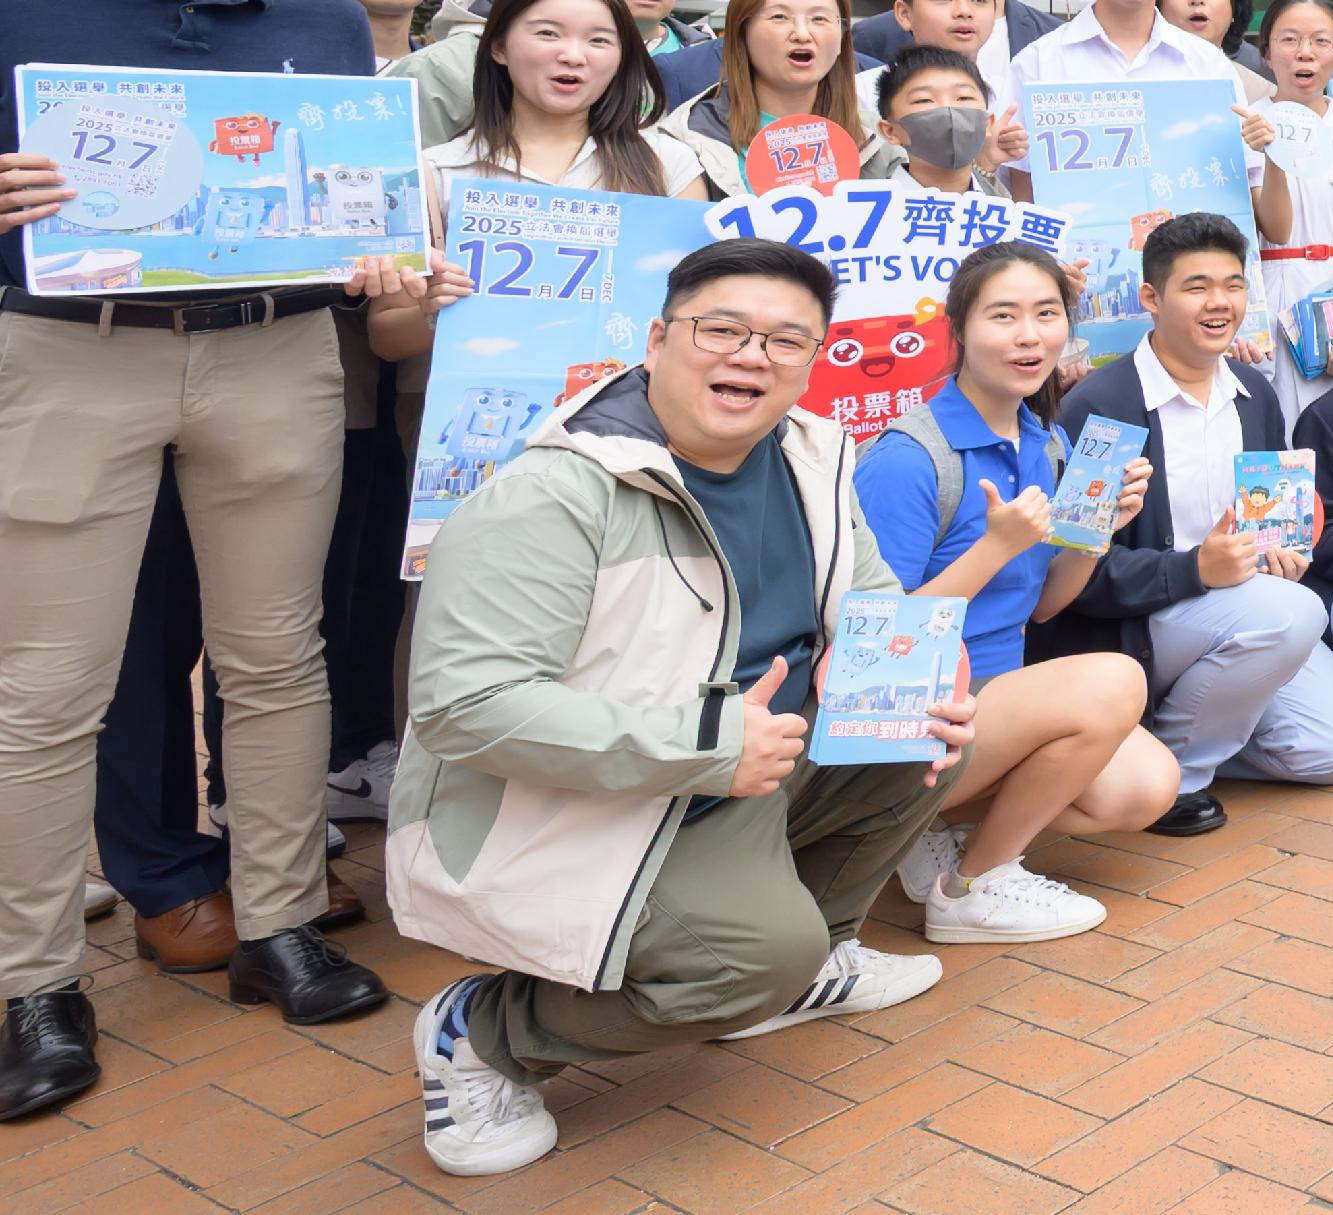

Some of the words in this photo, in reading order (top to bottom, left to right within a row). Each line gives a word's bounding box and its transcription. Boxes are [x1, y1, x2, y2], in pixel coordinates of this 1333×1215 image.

[76, 117, 113, 132] 2025
[1036, 112, 1077, 127] 2025
[466, 190, 538, 209] 投入選舉
[552, 199, 619, 217] 共創未來
[462, 216, 522, 235] 2025
[834, 255, 901, 284] ET'S
[830, 387, 923, 423] 投票箱
[843, 420, 883, 435] Ballot
